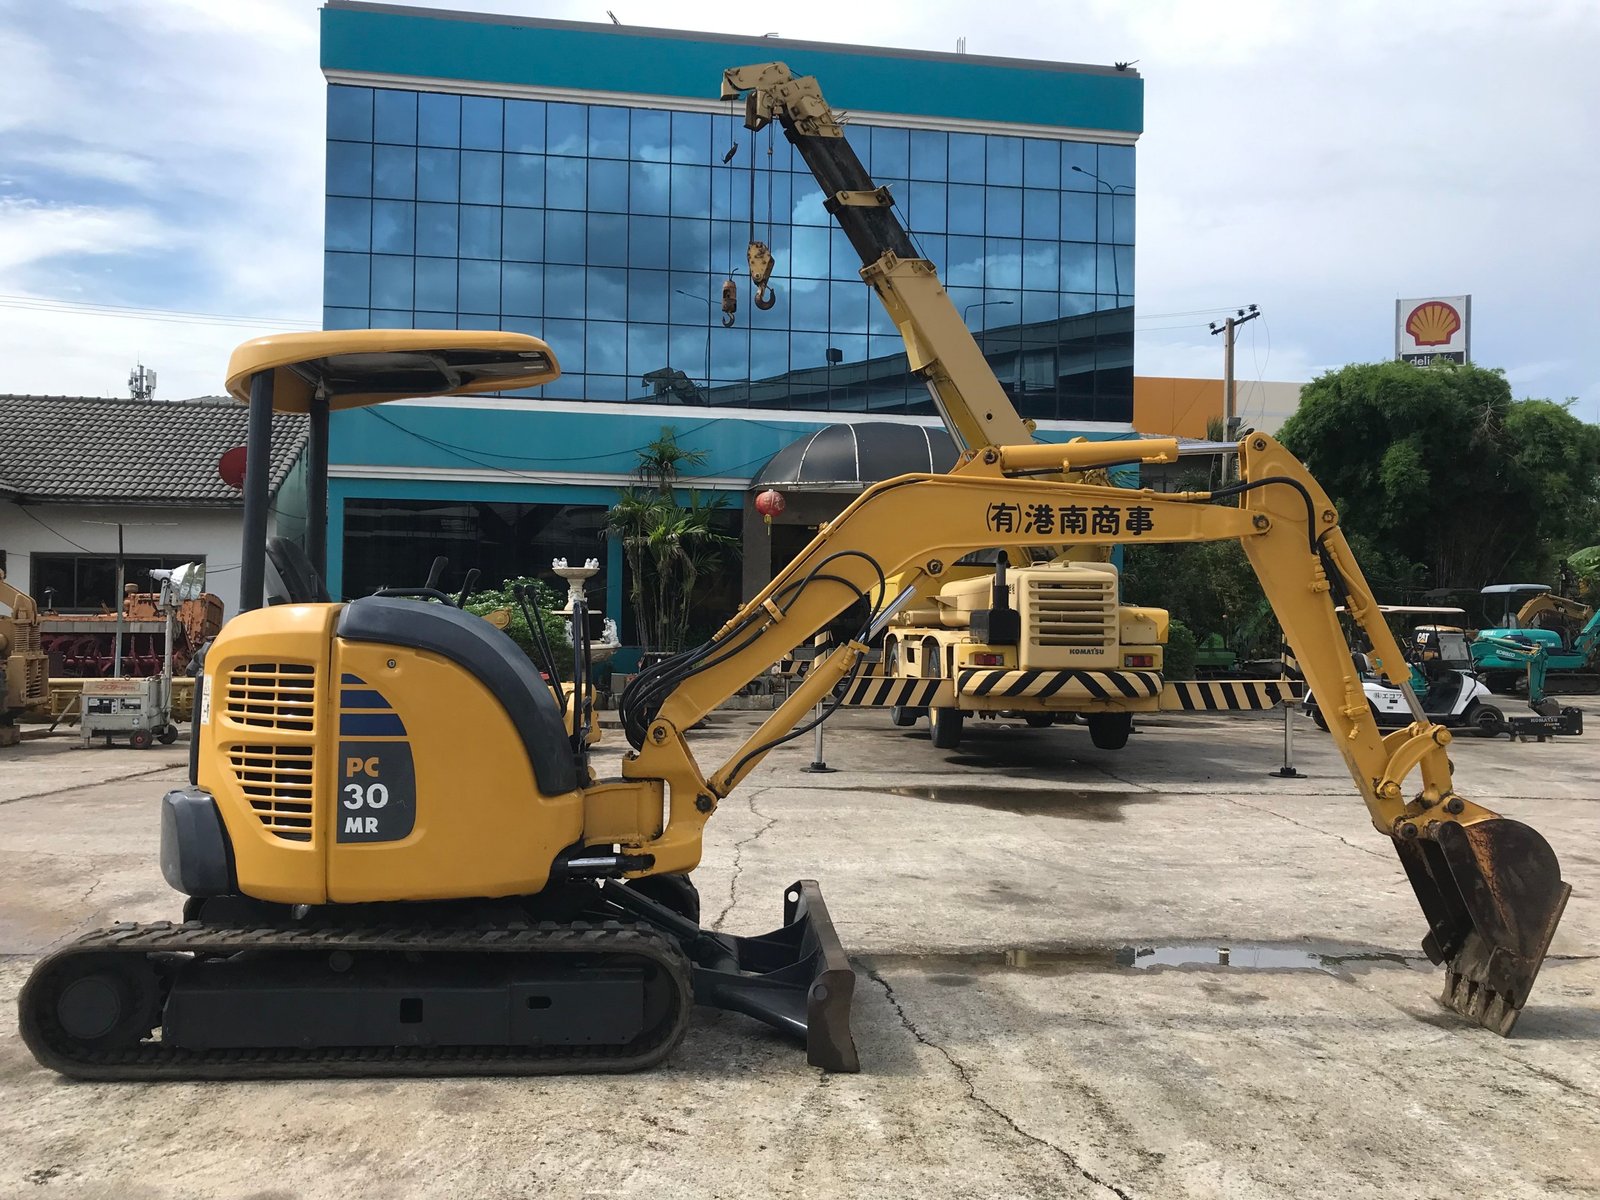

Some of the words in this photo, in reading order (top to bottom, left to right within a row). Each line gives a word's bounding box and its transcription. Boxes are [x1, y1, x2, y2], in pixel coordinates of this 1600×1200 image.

[986, 502, 1155, 536] (有)港南商事
[1417, 632, 1430, 644] CAT
[1069, 648, 1105, 656] KOMATSU
[346, 757, 380, 778] PC
[343, 783, 389, 810] 30
[344, 817, 379, 833] MR
